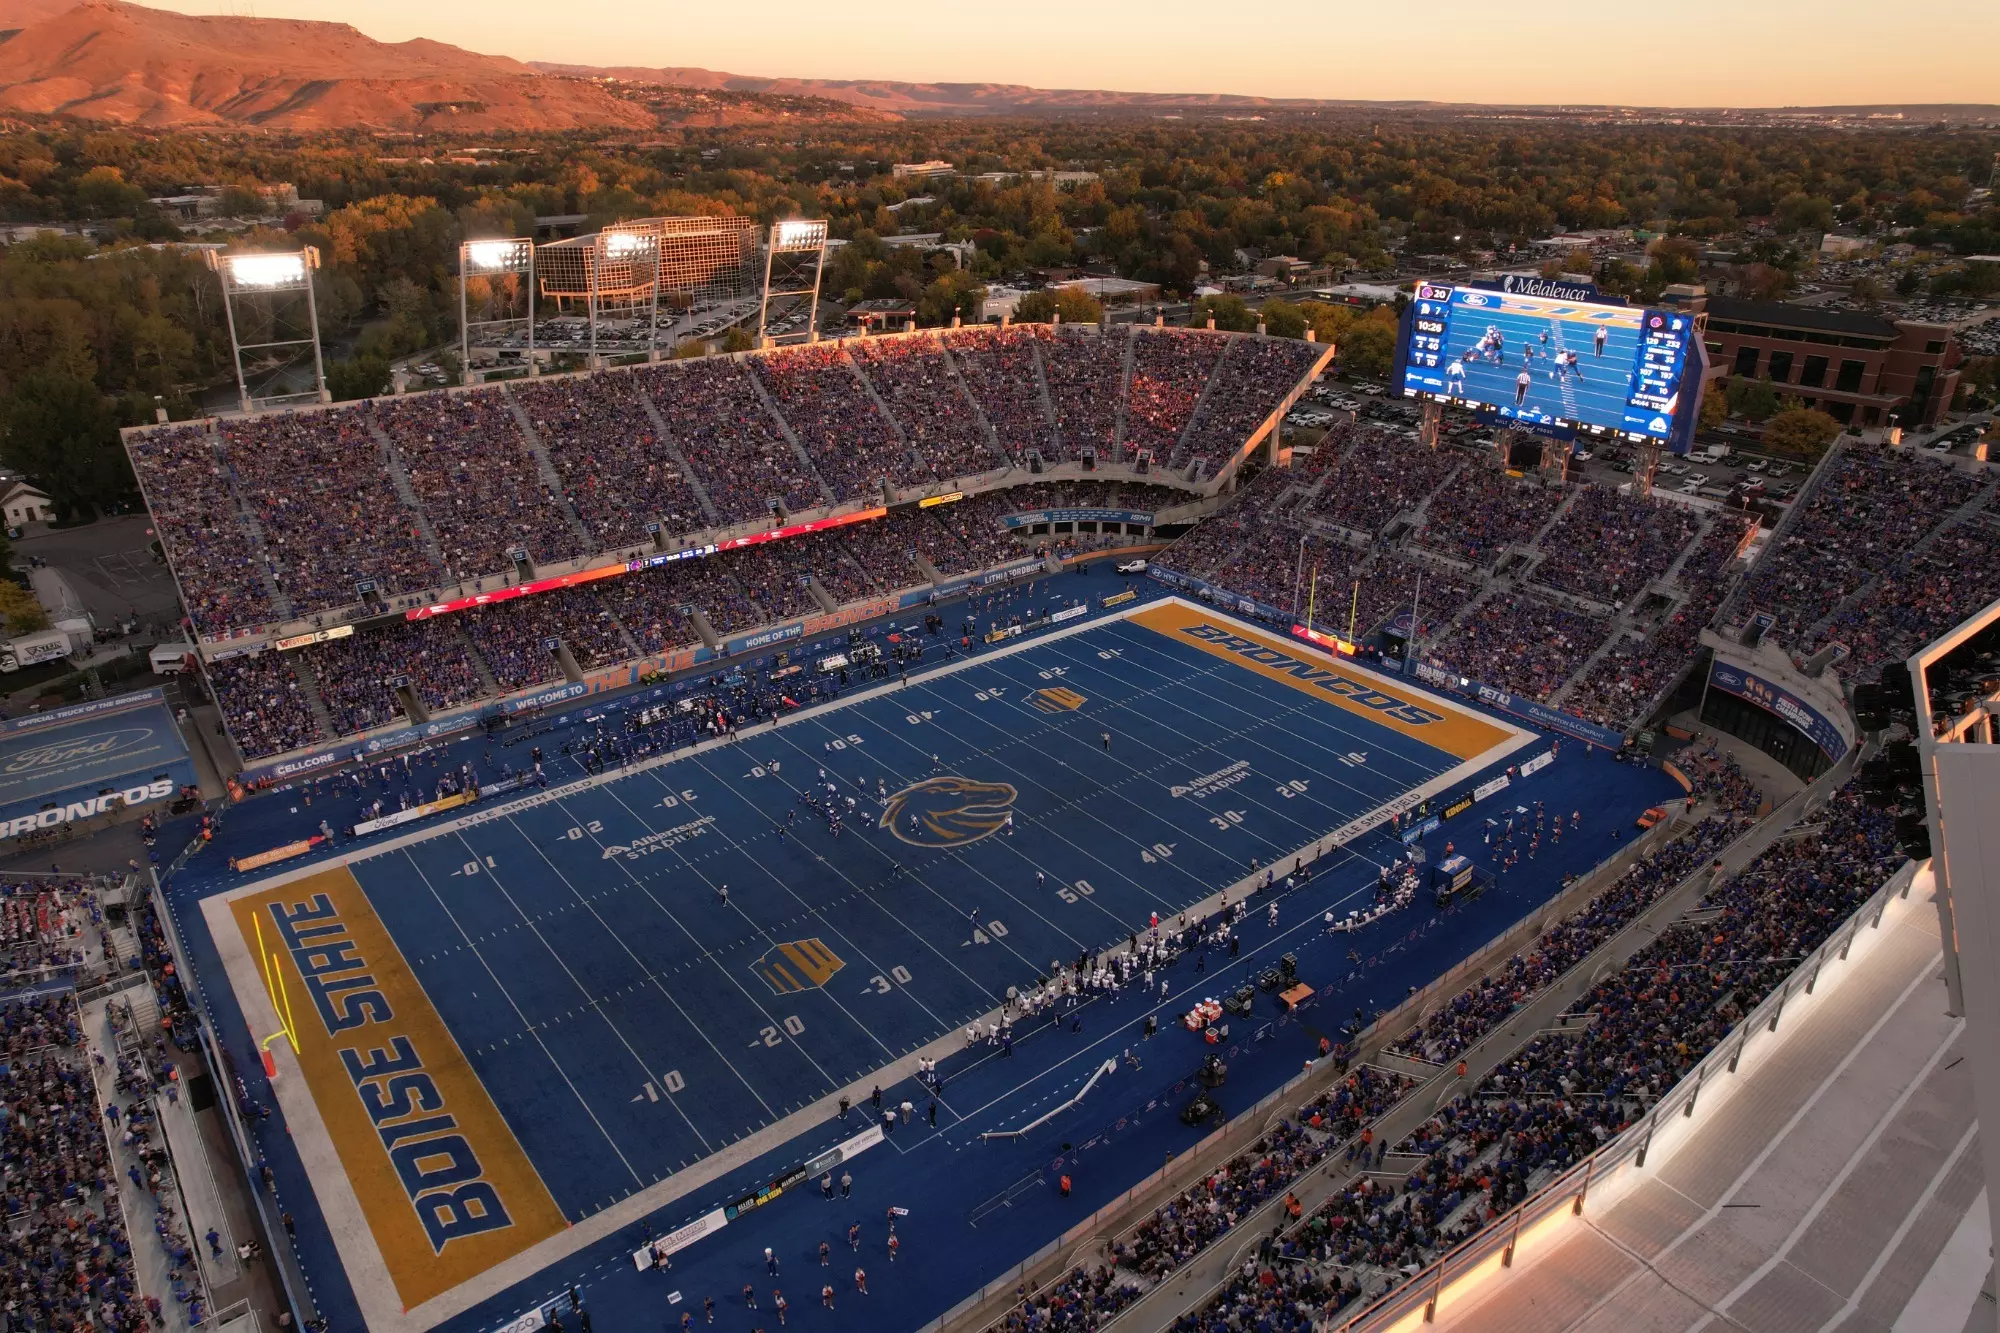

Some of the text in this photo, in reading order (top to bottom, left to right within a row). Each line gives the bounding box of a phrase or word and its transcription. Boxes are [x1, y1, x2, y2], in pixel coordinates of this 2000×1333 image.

[1434, 290, 1446, 299] 20
[1465, 294, 1485, 305] Ford
[1515, 278, 1586, 301] Melaleuca
[1435, 307, 1442, 315] 7
[1418, 321, 1442, 333] 10:26
[1508, 418, 1535, 434] Ford
[746, 596, 900, 648] HOME OF THE BRONCOS
[278, 635, 313, 648] WESTERN
[1097, 648, 1123, 659] 10
[1038, 666, 1066, 680] 20
[1177, 623, 1447, 726] BRONCOS
[1416, 663, 1447, 679] IDAHO
[1718, 672, 1739, 685] Ford
[515, 690, 567, 710] WELCOME
[570, 685, 583, 695] TO
[584, 667, 632, 696] THE
[974, 687, 1004, 701] 30
[1479, 686, 1511, 705] PET IQ
[17, 692, 153, 727] OFFICIAL TRUCK OF THE BRONCOS
[1775, 703, 1810, 729] CHAMPIONS
[1777, 697, 1799, 715] FIESTA
[905, 710, 933, 725] 40
[832, 734, 865, 750] 50
[4, 735, 119, 773] Ford
[277, 753, 336, 775] CELLCORE
[1338, 752, 1367, 767] 10
[1189, 759, 1250, 789] Albertsons
[1193, 770, 1251, 799] STADIUM
[662, 788, 698, 808] 30
[1276, 779, 1308, 799] 20
[456, 810, 495, 827] LYLE
[501, 795, 547, 811] SMITH
[552, 780, 593, 797] FIELD
[1361, 808, 1393, 828] SMITH
[1392, 793, 1421, 813] FIELD
[1445, 798, 1472, 819] KENDALL
[374, 815, 399, 829] Ford
[567, 820, 604, 841] 20
[1209, 810, 1244, 830] 30
[631, 815, 716, 849] Albertsons
[1403, 828, 1421, 843] CAMPIN
[627, 828, 707, 860] STADIUM
[1140, 843, 1173, 864] 40
[464, 856, 497, 876] 10
[1056, 879, 1095, 904] 50
[974, 920, 1009, 944] 40
[267, 893, 394, 1039] STATE
[869, 965, 912, 994] 30
[760, 1015, 805, 1048] 20
[643, 1070, 686, 1103] 10
[337, 1035, 515, 1257] BOISE
[737, 1198, 755, 1211] ALLIED
